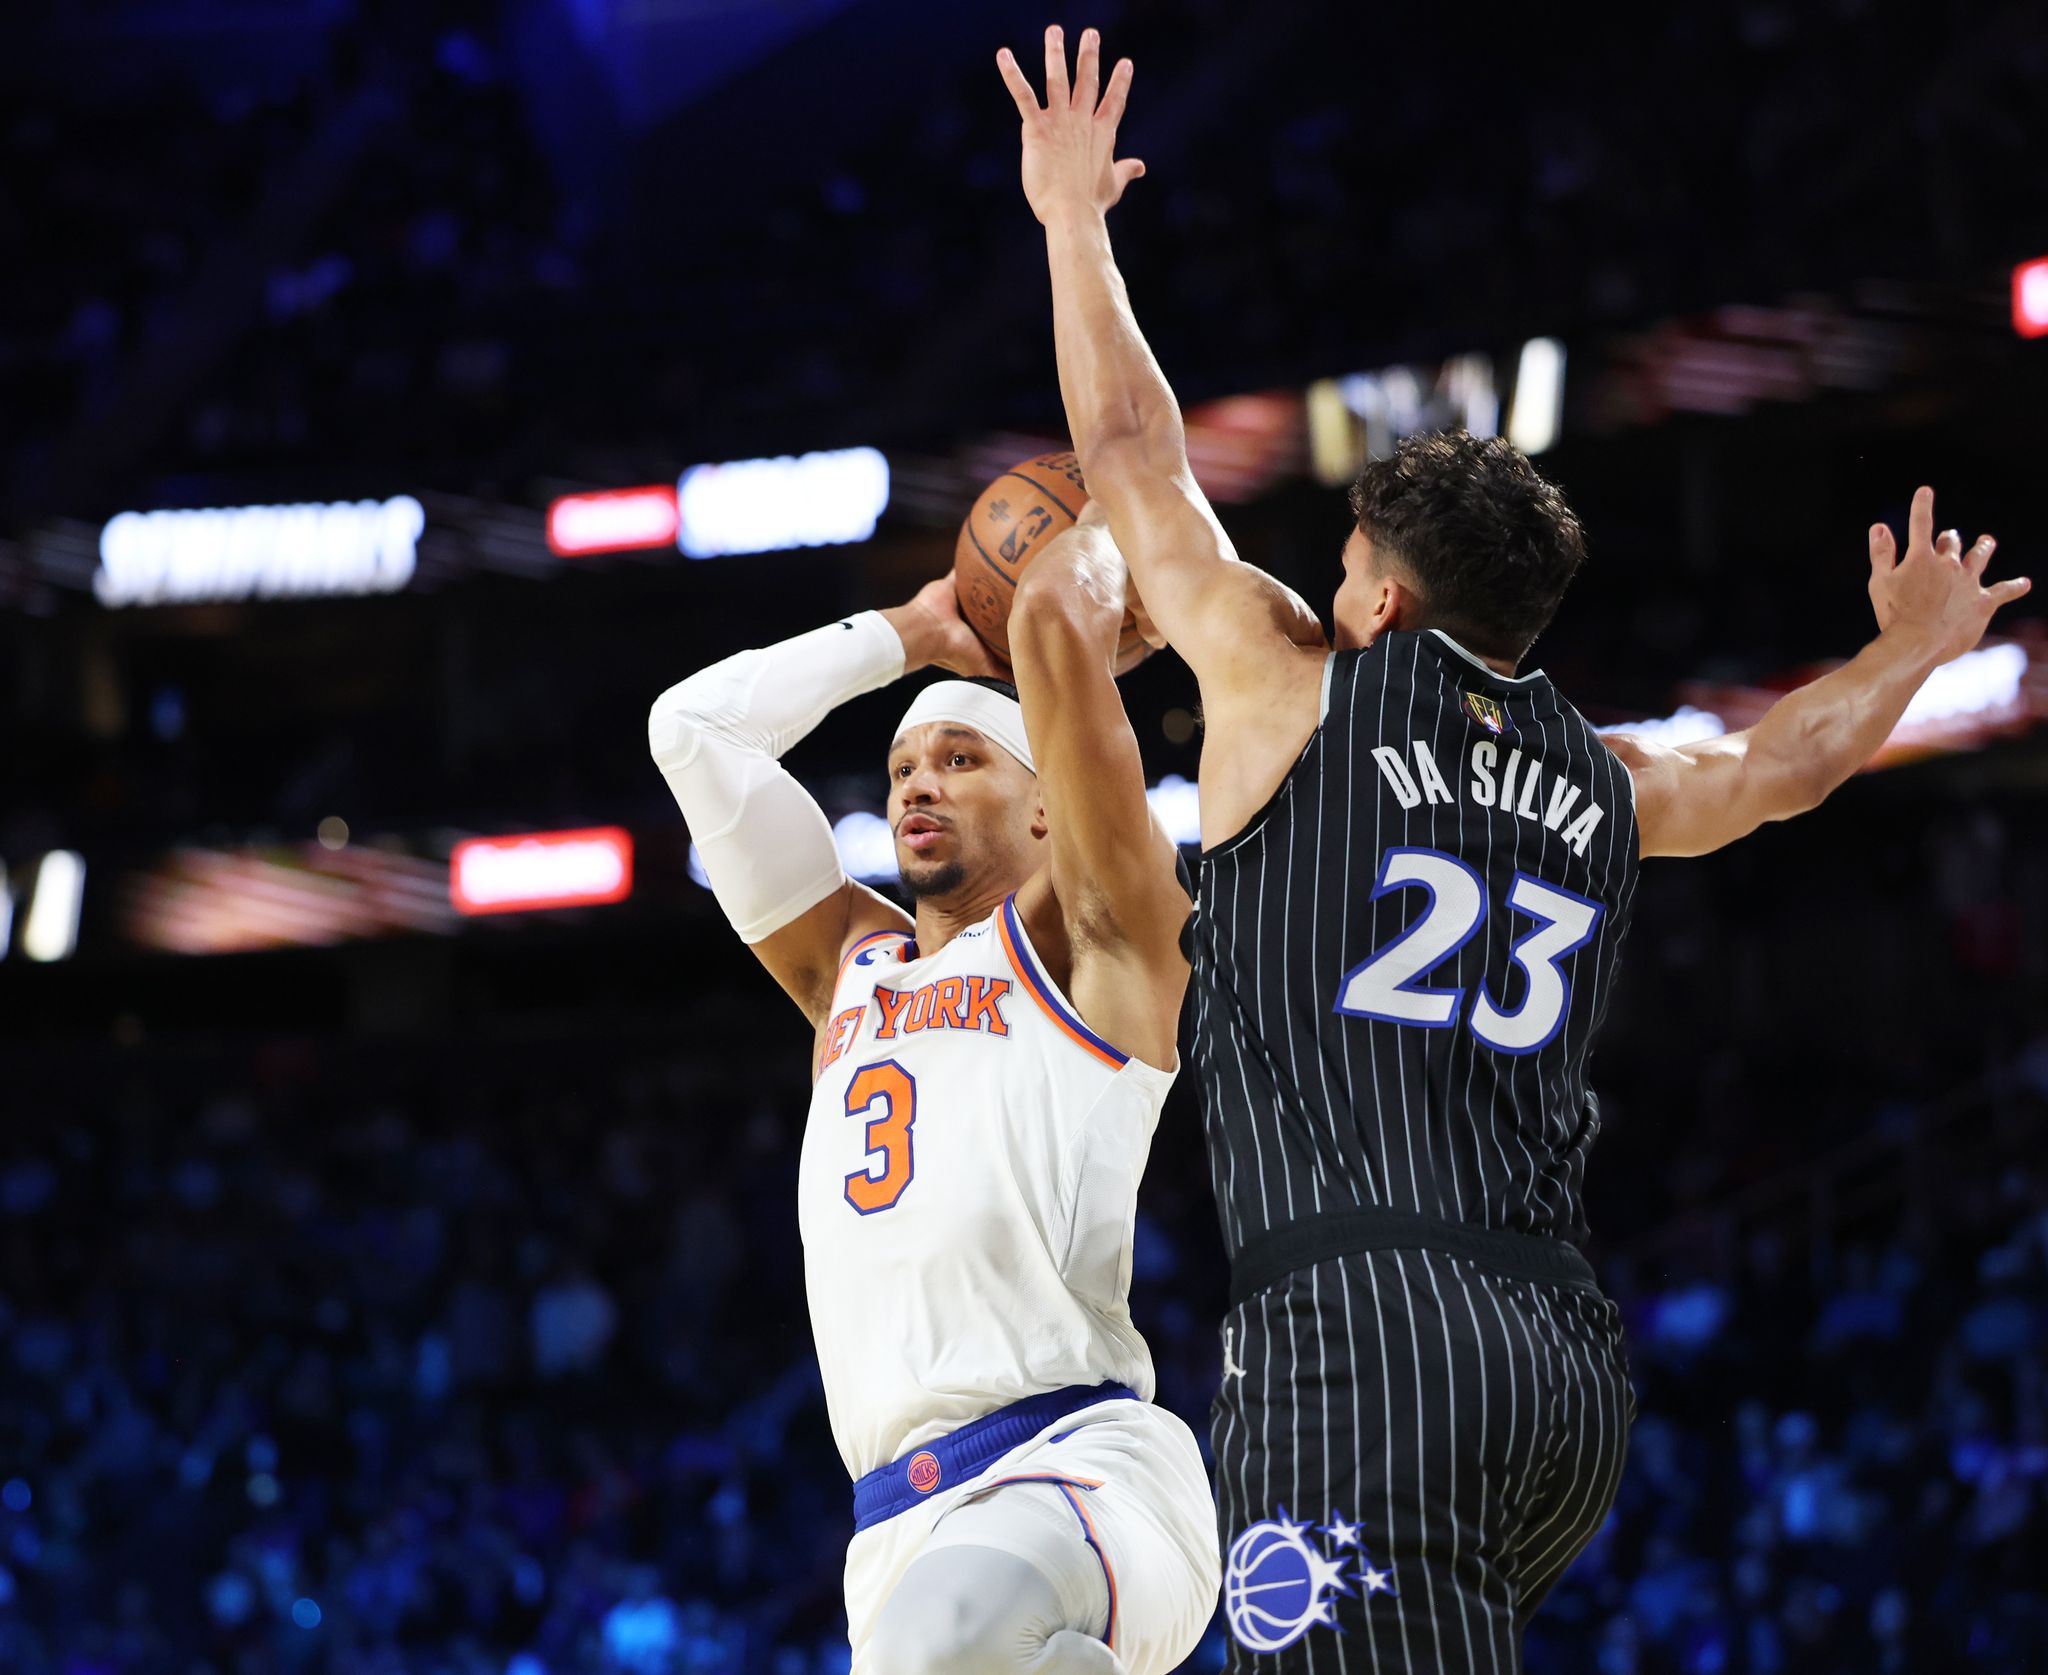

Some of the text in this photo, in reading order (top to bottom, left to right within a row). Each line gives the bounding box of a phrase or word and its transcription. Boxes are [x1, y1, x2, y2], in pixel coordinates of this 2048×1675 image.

[1371, 740, 1605, 858] DA SILVA
[872, 975, 1013, 1041] YORK
[1333, 846, 1607, 1057] 23
[844, 1058, 917, 1216] 3
[911, 1461, 937, 1484] KNICKS
